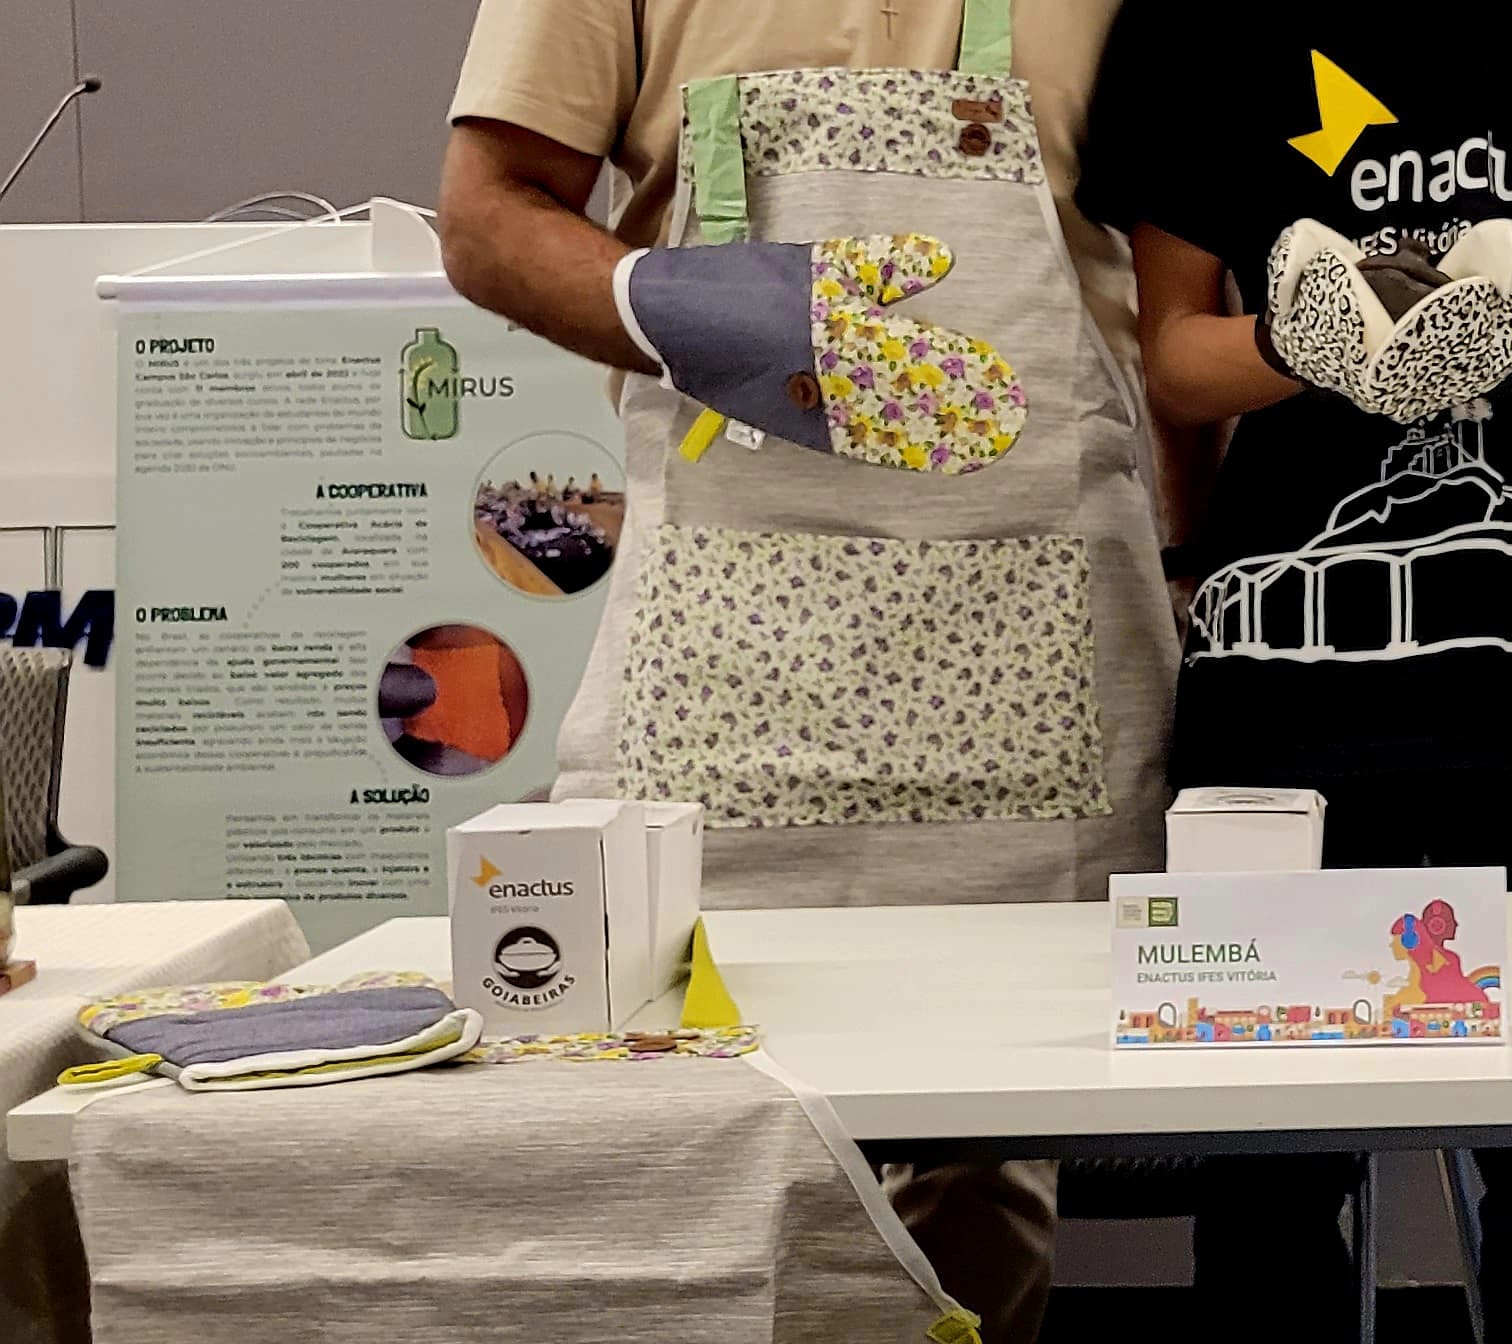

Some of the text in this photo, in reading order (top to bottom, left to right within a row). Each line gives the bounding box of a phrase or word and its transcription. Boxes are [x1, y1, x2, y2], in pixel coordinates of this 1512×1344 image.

[136, 338, 215, 354] O PROJETO
[428, 376, 515, 398] MIRUS
[316, 483, 428, 499] A COOPERATIVA
[136, 606, 227, 623] O PROBLEMA
[350, 783, 430, 805] A SOLUÇÃO
[489, 878, 574, 898] enactus
[1138, 938, 1261, 964] MULEMBÁ
[1137, 969, 1277, 983] ENACTUS IFES VITÓRIA
[482, 975, 576, 1005] GOIABEIRAS
